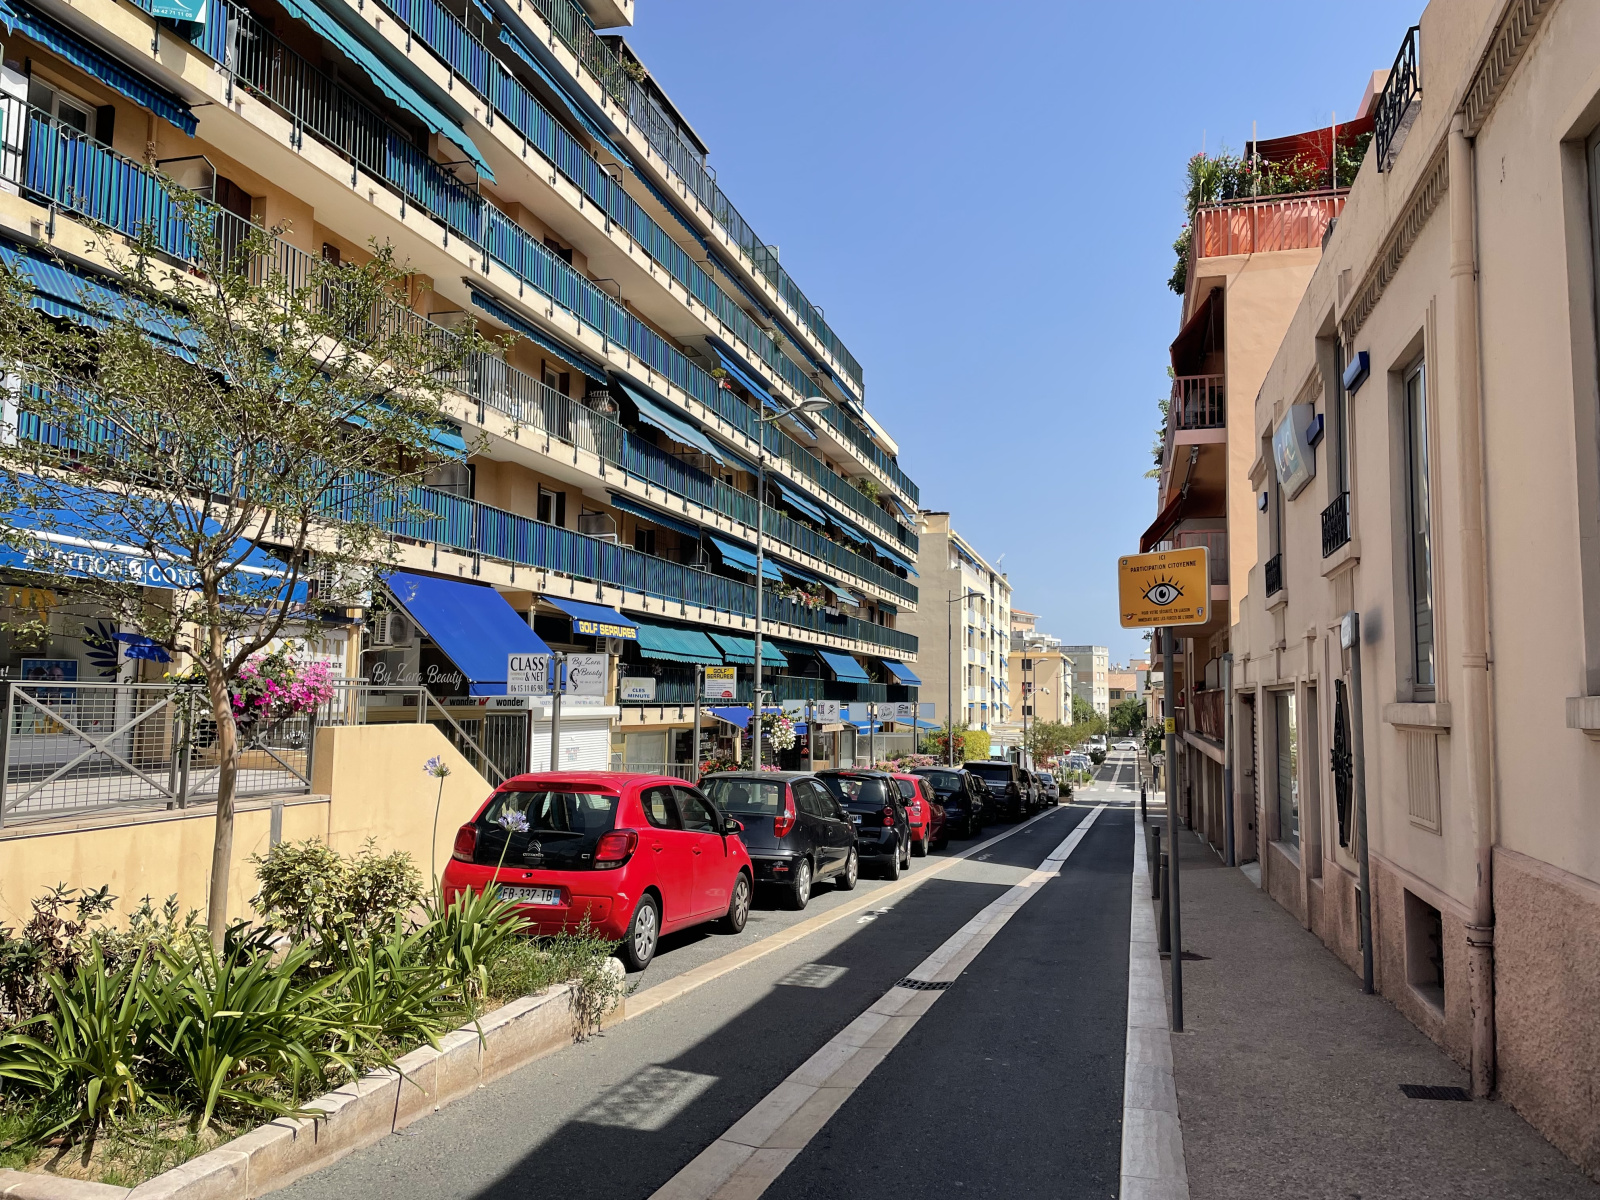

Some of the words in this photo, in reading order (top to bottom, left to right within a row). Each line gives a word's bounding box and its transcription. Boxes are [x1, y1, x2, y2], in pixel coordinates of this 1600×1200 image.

[1130, 563, 1166, 573] PARTICIPATION
[1167, 560, 1197, 569] CITOYENNE
[578, 621, 598, 634] GOLF
[599, 624, 637, 639] SERRURES
[510, 656, 544, 671] CLASS
[525, 672, 530, 682] &
[531, 672, 544, 682] NET
[449, 698, 477, 706] wonder
[496, 698, 524, 707] wonder
